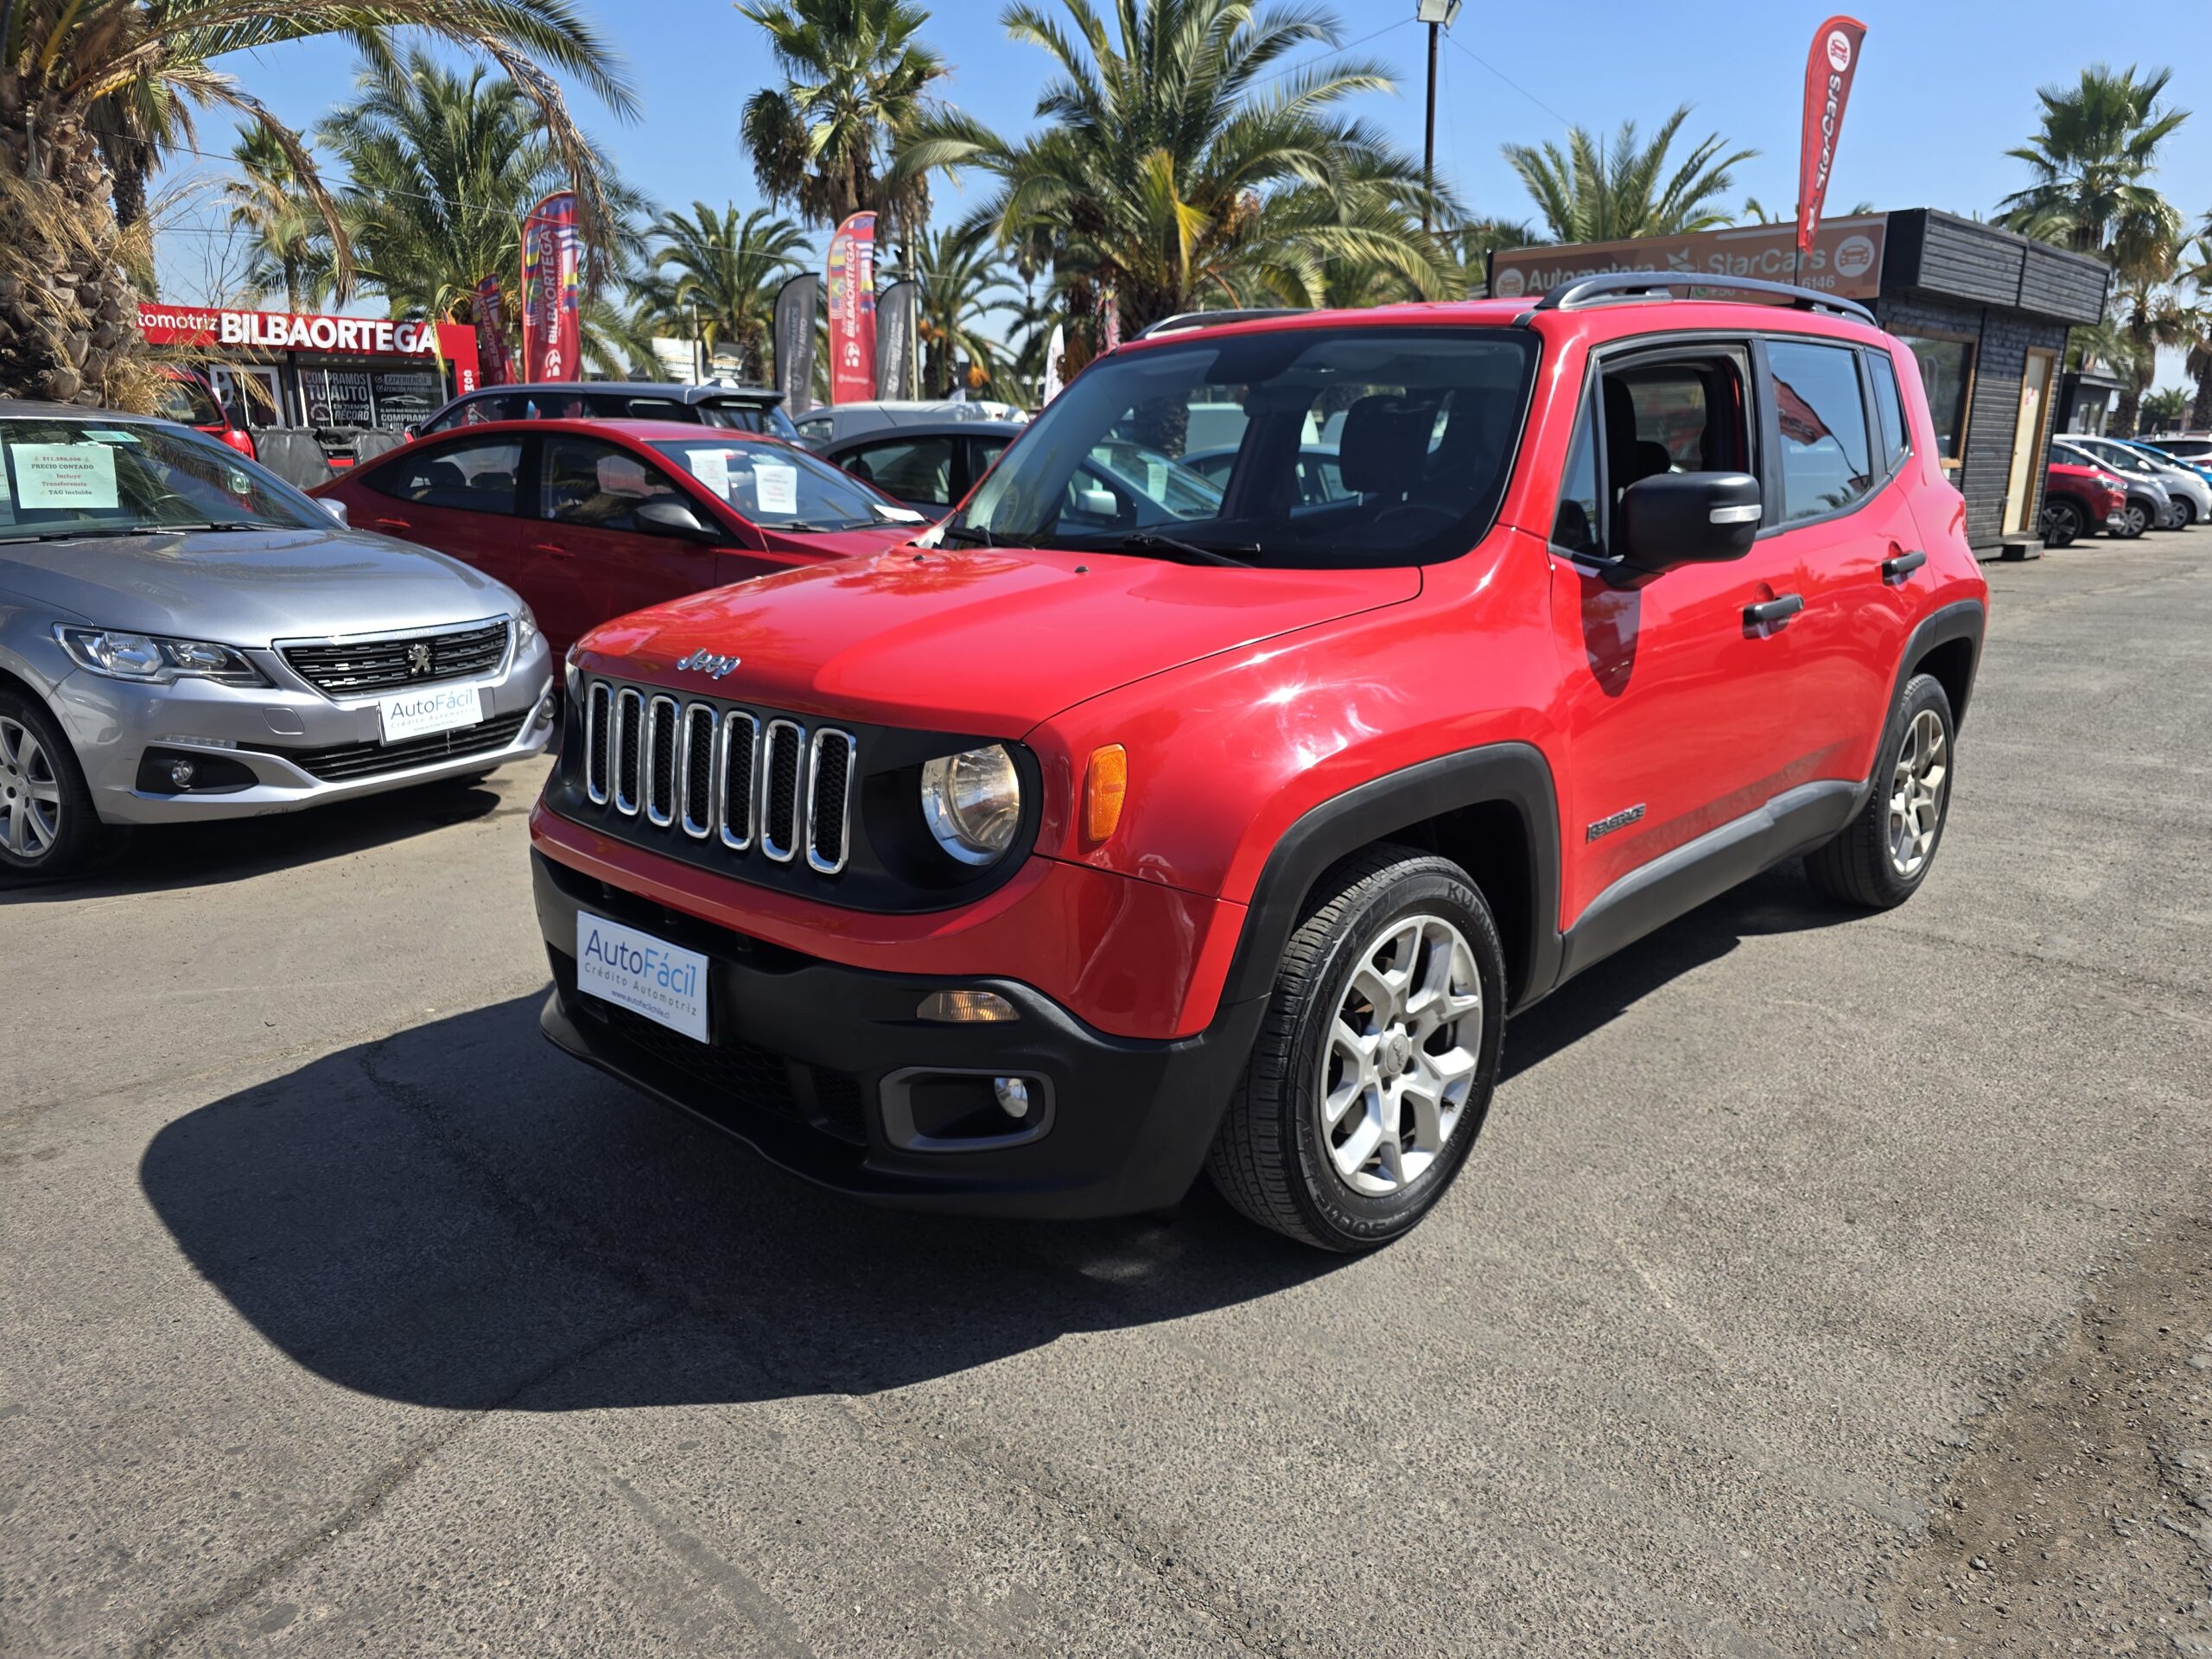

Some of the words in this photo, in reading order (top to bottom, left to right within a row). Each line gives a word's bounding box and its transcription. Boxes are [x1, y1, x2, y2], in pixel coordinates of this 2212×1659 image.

[1815, 73, 1841, 190] StarCars
[1707, 247, 1827, 276] StarCars
[540, 229, 558, 345] BILBAORTEGA
[846, 241, 855, 338] BILBAORTEGA
[1802, 276, 1835, 289] 6146
[137, 311, 218, 331] tomotriz
[219, 312, 437, 353] BILBAORTEGA
[480, 299, 500, 367] BILBAORTEGA
[305, 372, 366, 385] COMPRAMOS
[306, 385, 327, 401] TU
[331, 385, 367, 401] AUTO
[386, 376, 428, 385] EXPERIENCIA
[381, 413, 429, 423] COMPRAM
[677, 647, 741, 680] Jeep
[391, 689, 473, 720] AutoFácil
[585, 929, 697, 998] AutoFácil
[584, 963, 628, 986] Crédito
[632, 981, 697, 1017] Automotriz
